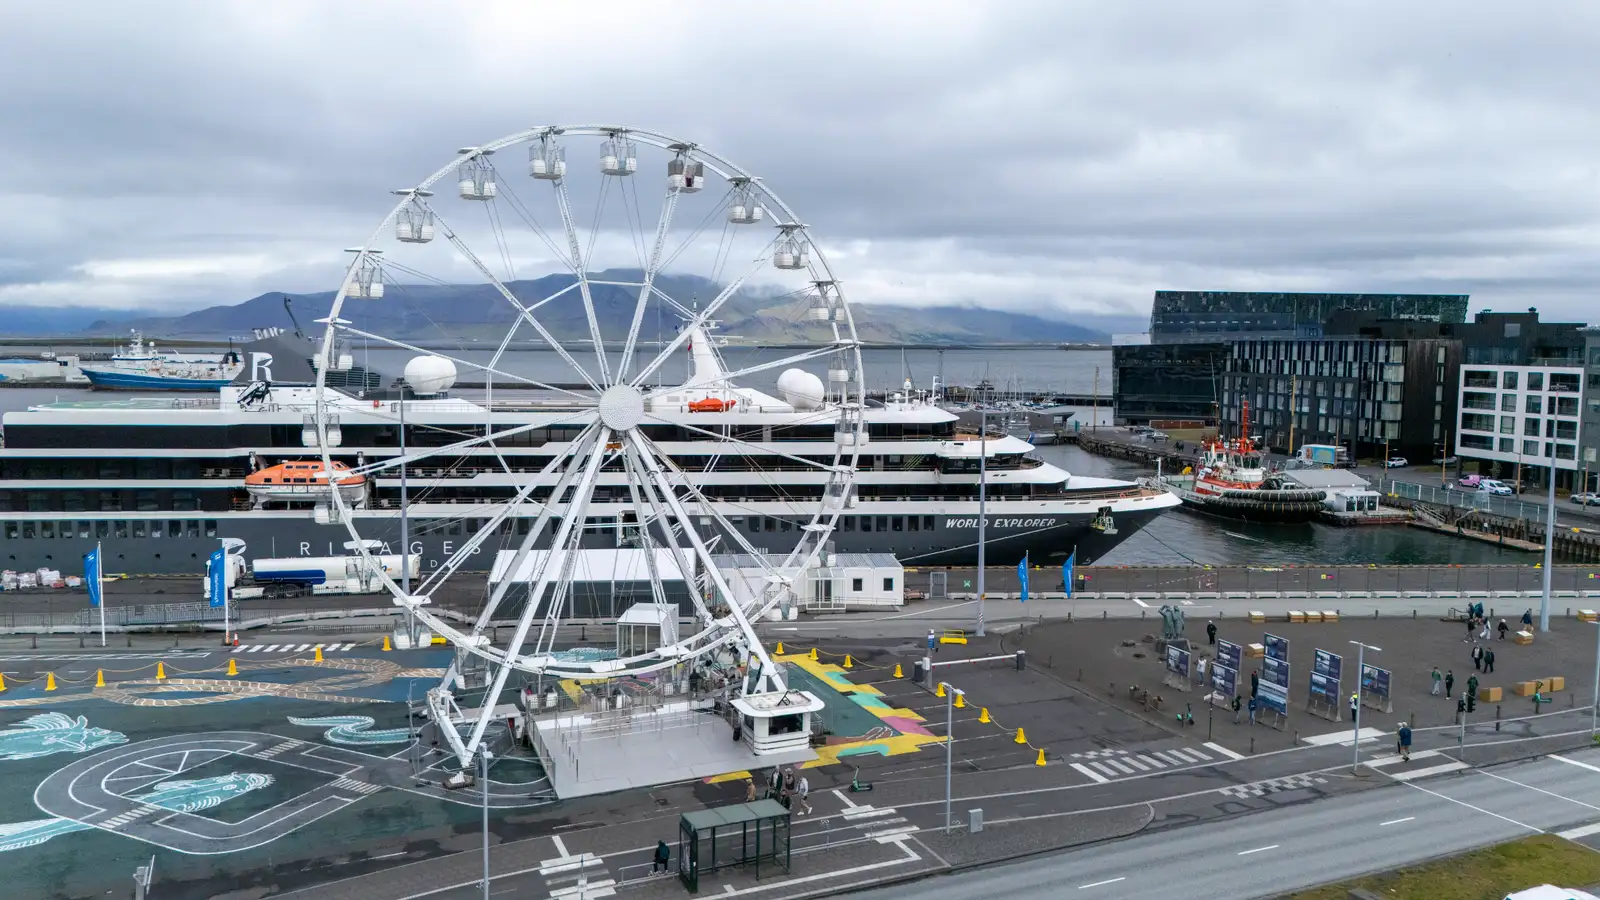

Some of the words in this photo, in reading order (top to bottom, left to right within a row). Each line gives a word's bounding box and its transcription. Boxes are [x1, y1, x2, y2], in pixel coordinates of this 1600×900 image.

[248, 351, 273, 382] R
[945, 518, 989, 529] WORLD
[993, 518, 1056, 528] EXPLORER
